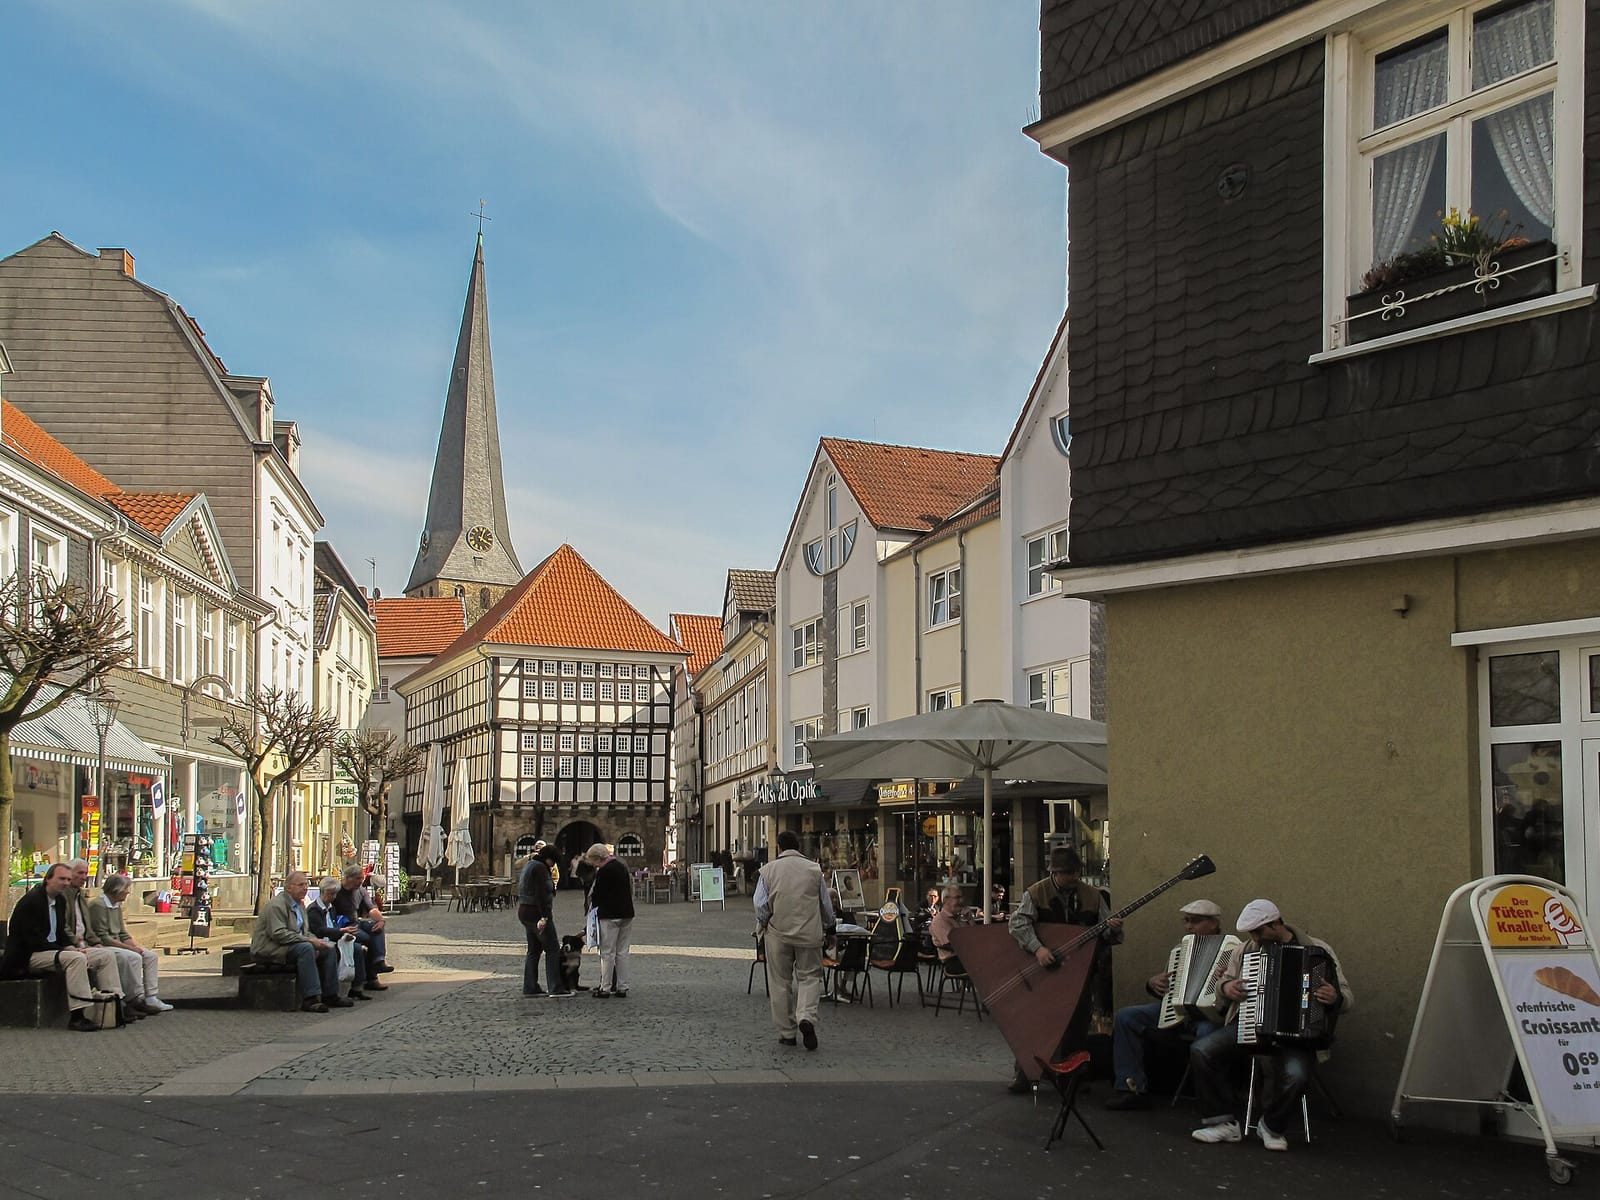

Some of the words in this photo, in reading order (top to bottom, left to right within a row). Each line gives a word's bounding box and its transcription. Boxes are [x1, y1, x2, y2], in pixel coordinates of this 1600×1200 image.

[272, 759, 279, 770] 8
[335, 786, 355, 795] Bastel
[790, 777, 817, 806] Optik
[334, 796, 355, 805] artikel
[1511, 897, 1529, 906] Der
[1491, 906, 1540, 919] Tüten-
[1496, 921, 1544, 933] Knaller
[1516, 1001, 1576, 1013] ofenfrische
[1558, 1038, 1569, 1047] für
[1583, 1081, 1592, 1089] in
